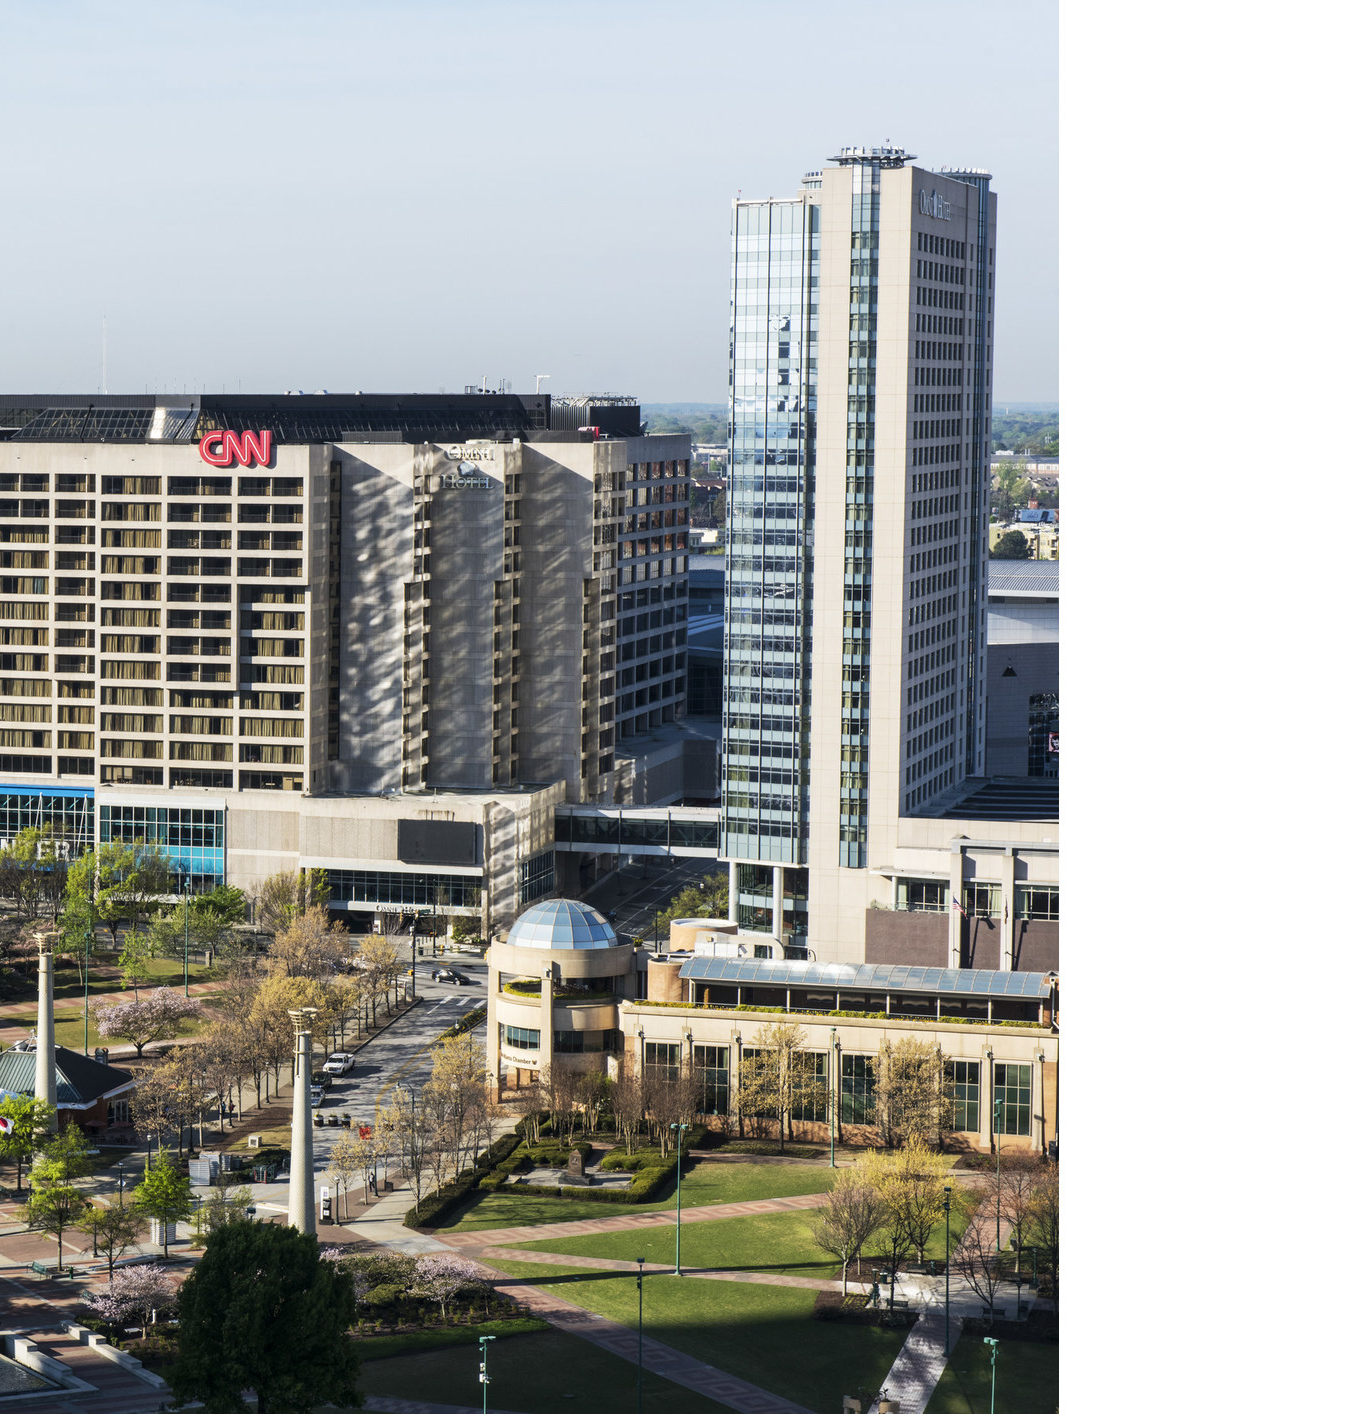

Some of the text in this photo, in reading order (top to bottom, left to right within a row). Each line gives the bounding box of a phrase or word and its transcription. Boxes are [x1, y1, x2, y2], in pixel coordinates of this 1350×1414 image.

[199, 430, 272, 467] CNN
[447, 445, 496, 461] OMNI
[440, 473, 495, 489] HOTEL
[513, 1056, 531, 1064] Chamber
